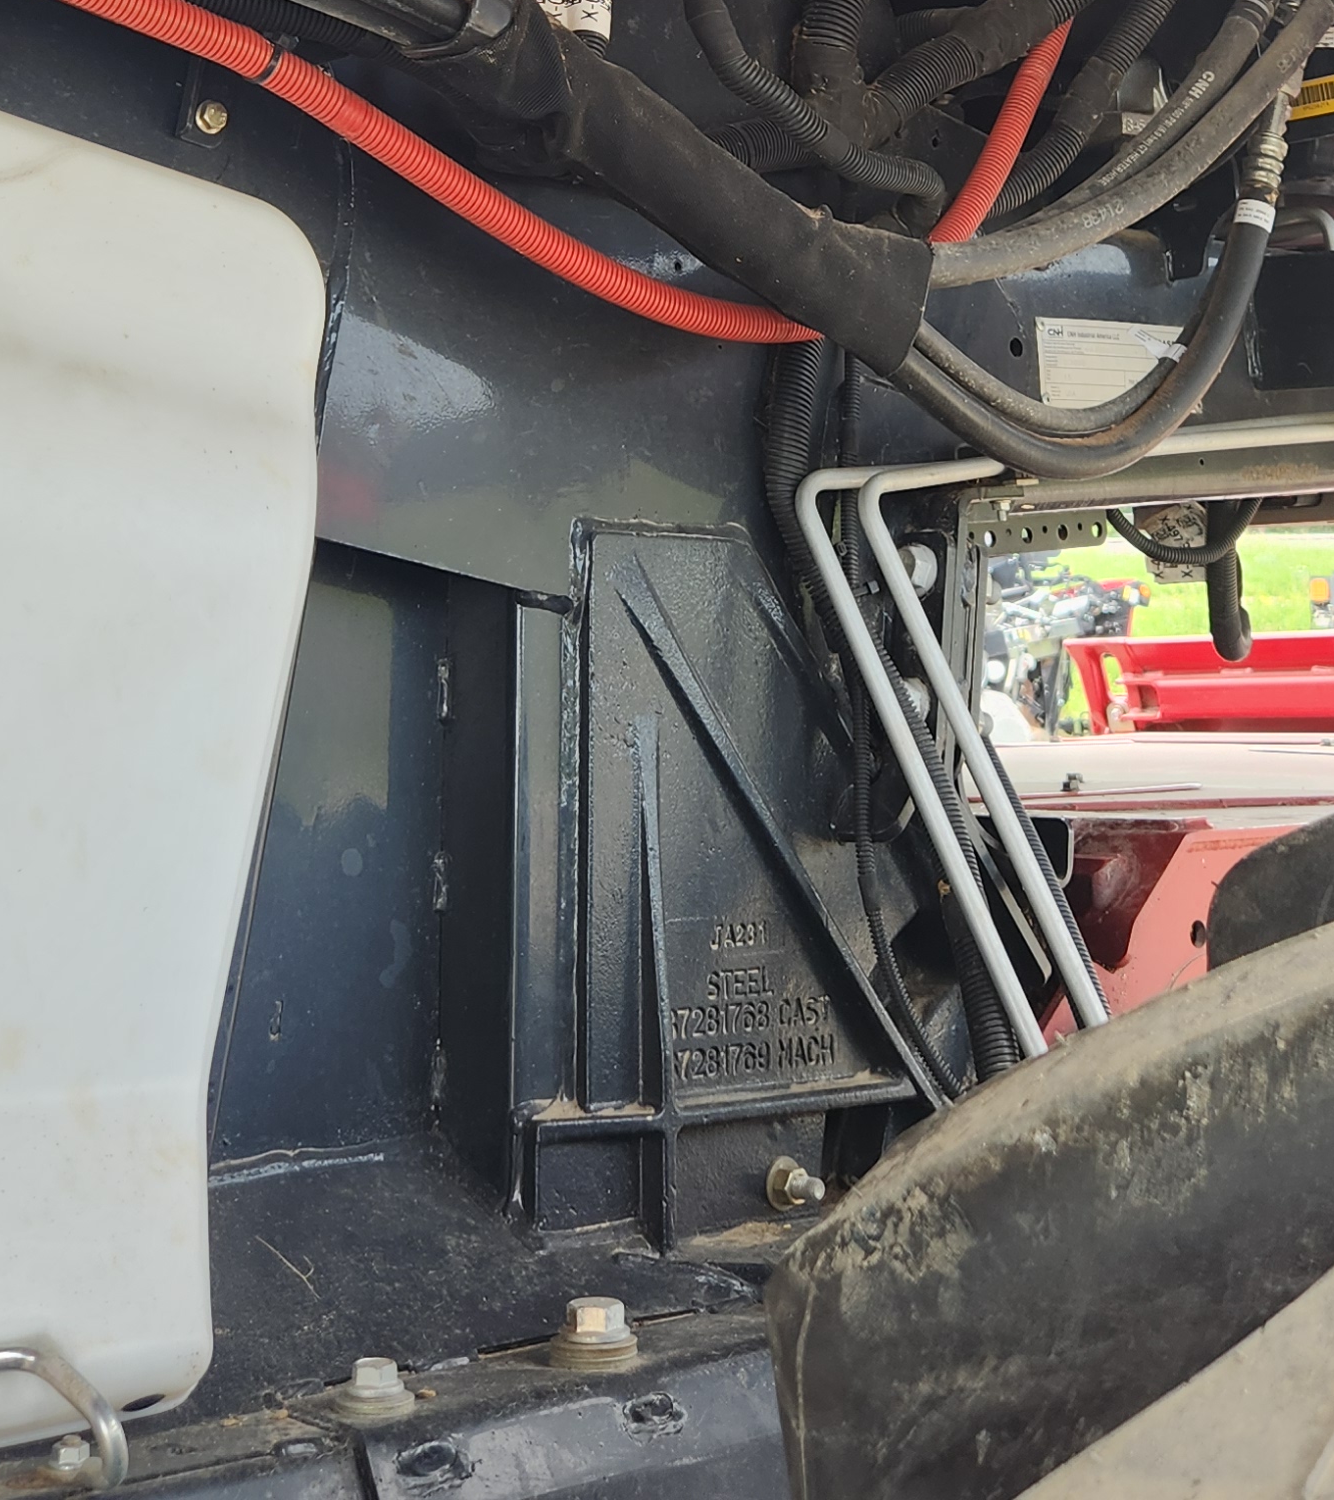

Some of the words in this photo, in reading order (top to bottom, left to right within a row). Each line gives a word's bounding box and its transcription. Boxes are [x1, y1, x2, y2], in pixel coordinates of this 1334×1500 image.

[1191, 70, 1215, 100] CNH
[707, 966, 774, 1000] STEEL
[778, 995, 830, 1027] CAST
[778, 1033, 835, 1070] MACH
